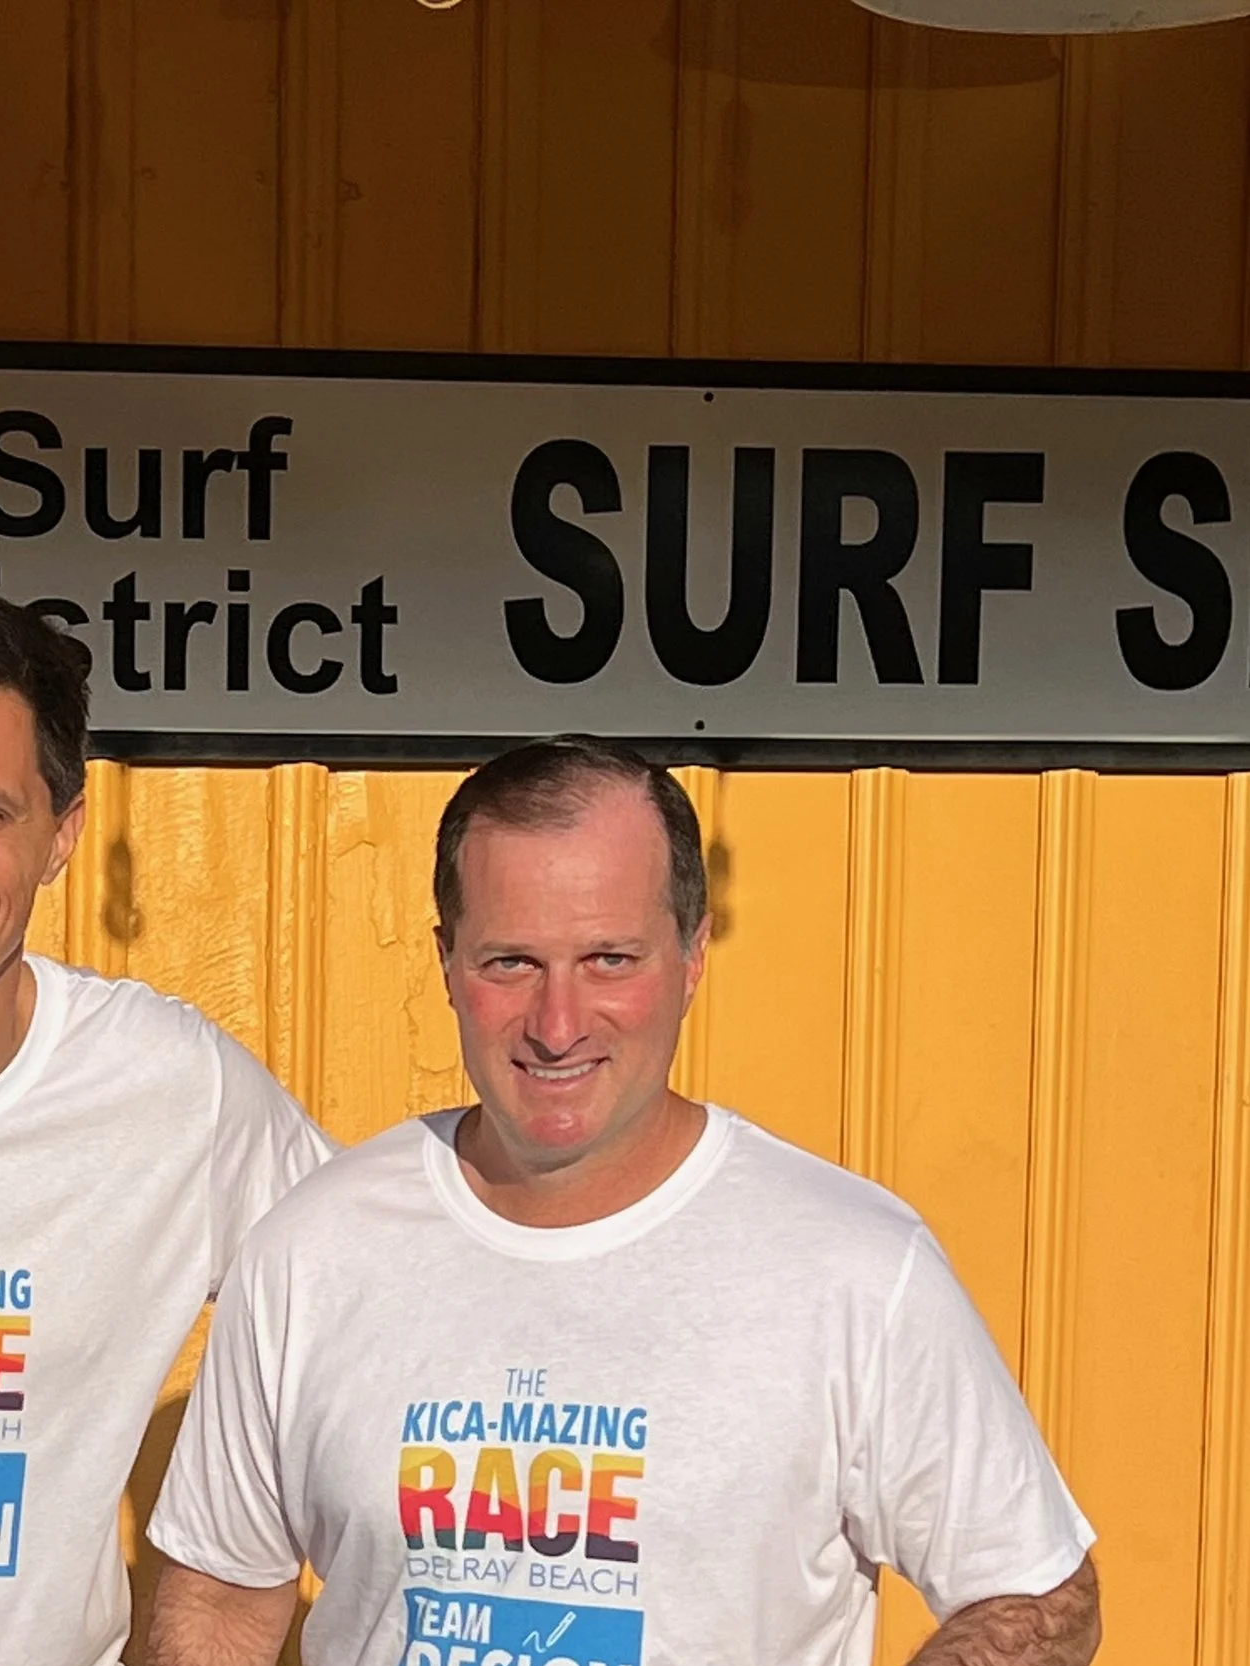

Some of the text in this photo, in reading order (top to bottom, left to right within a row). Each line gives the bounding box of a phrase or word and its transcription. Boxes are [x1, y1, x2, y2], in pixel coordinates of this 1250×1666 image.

[504, 439, 1250, 691] SURF S
[506, 1369, 547, 1397] THE
[402, 1401, 647, 1449] KICA-MAZING
[399, 1447, 645, 1563] RACE
[407, 1557, 637, 1596] DELRAY BEACH
[414, 1595, 491, 1644] TEAM
